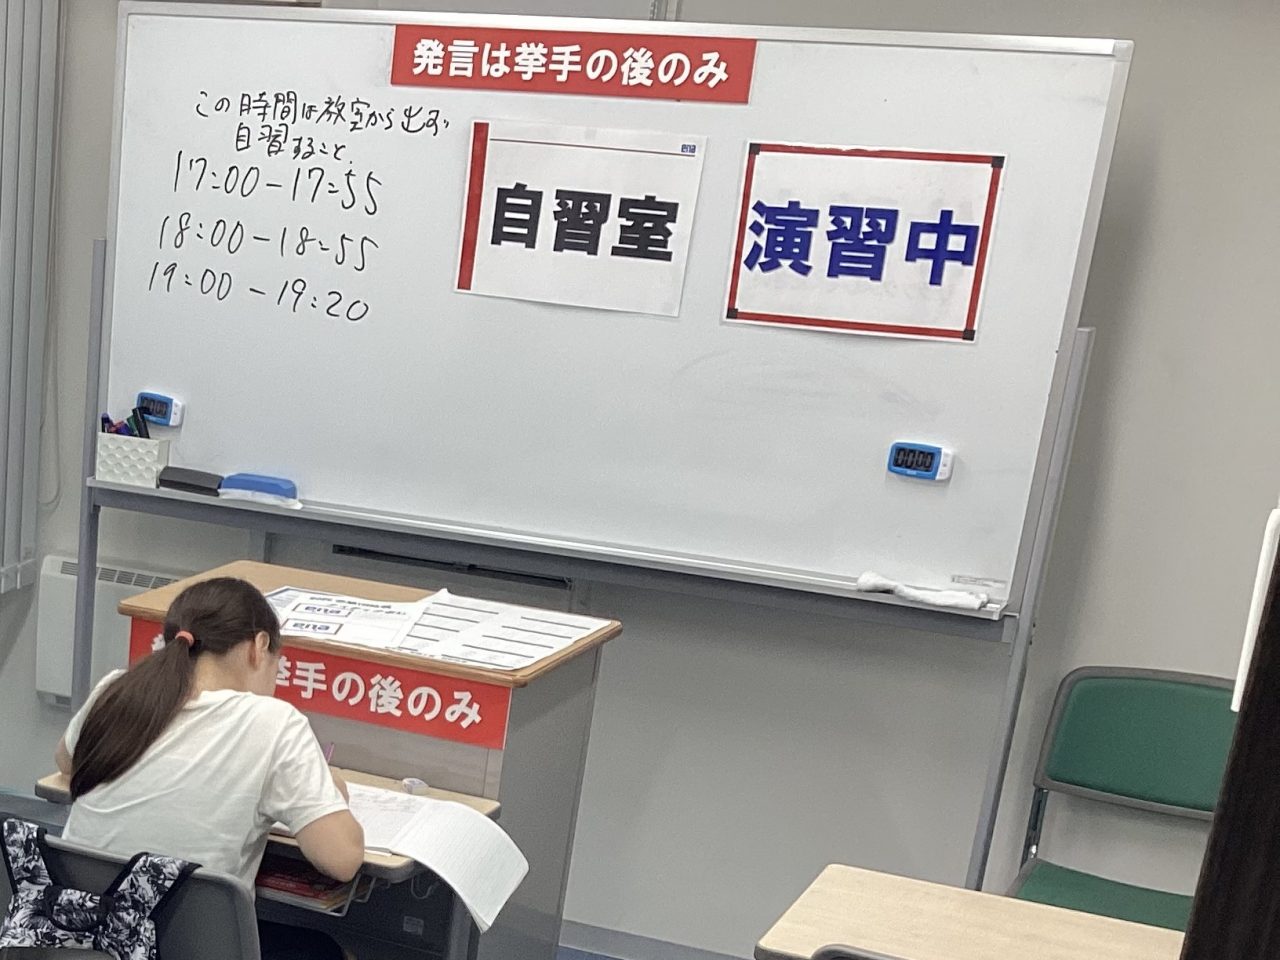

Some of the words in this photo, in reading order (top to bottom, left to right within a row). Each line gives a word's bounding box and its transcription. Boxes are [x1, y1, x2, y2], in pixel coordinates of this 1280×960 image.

[413, 38, 729, 88] 発言は挙手の後のみ
[490, 182, 679, 262] 自習室
[744, 200, 980, 286] 演習中
